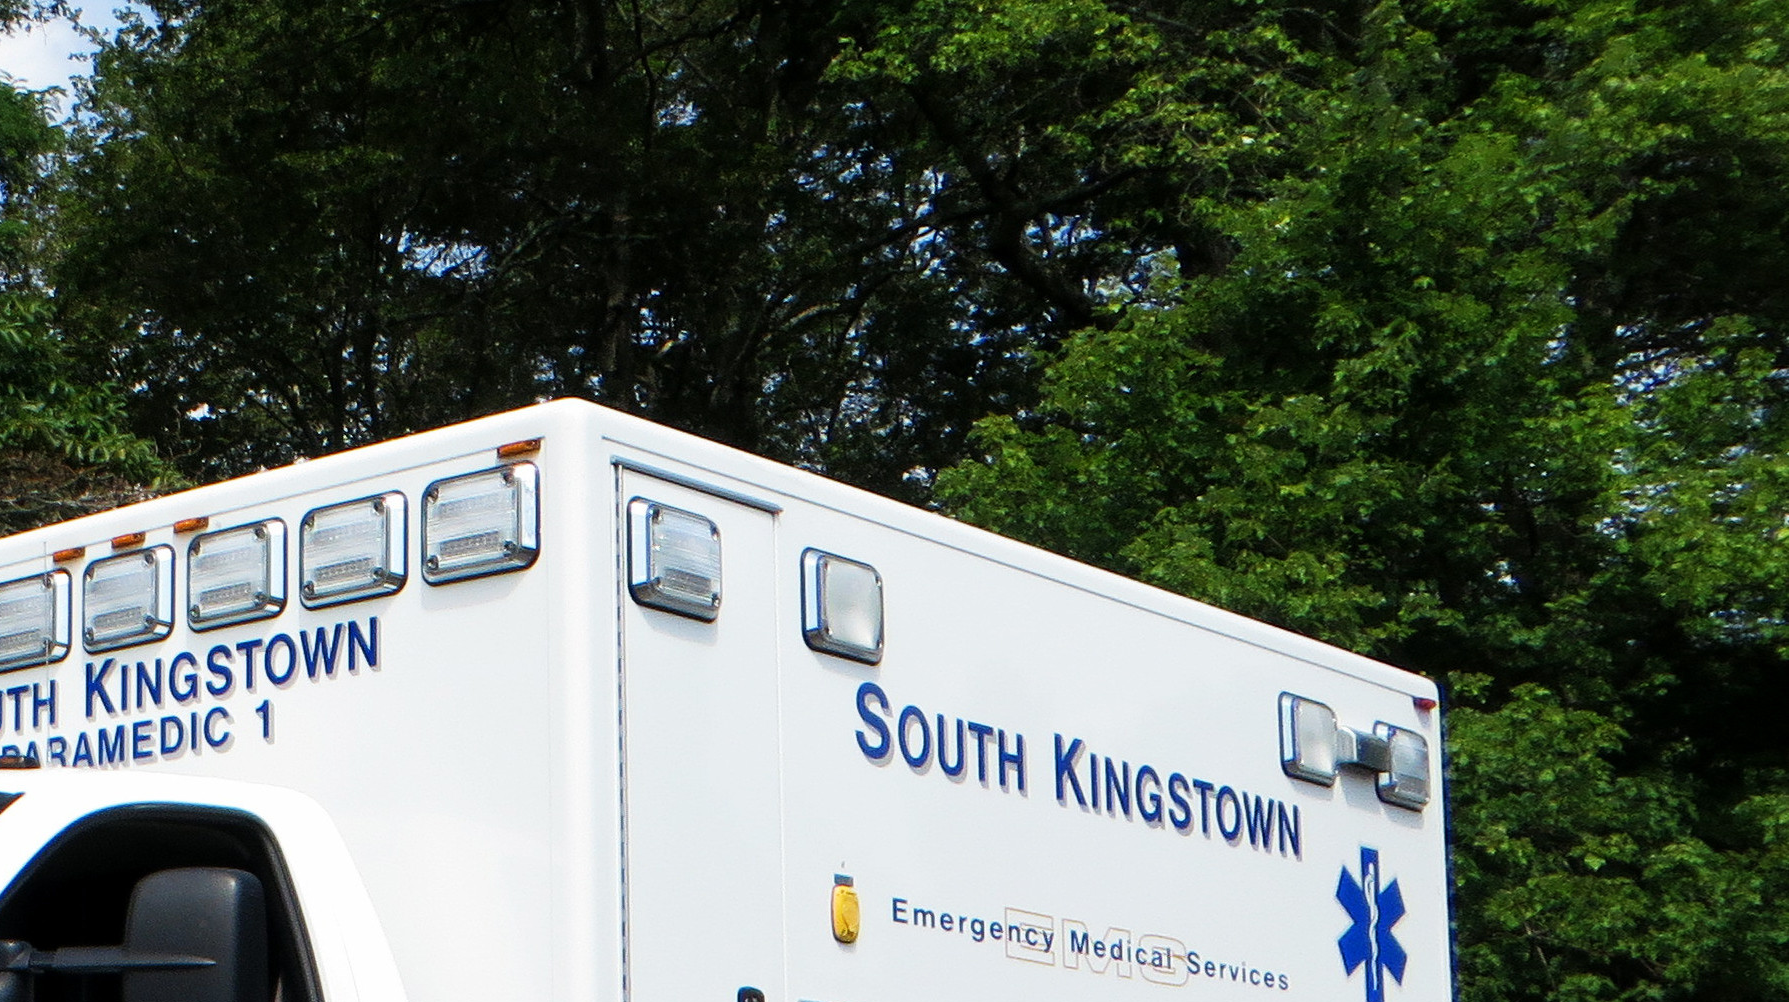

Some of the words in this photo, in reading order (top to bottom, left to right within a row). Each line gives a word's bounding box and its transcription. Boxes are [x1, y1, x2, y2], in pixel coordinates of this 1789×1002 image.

[83, 616, 381, 719] KINGSTOWN
[0, 706, 236, 768] RAMEDIC
[255, 699, 273, 741] 1
[854, 681, 1026, 793] SOUTH
[1053, 733, 1303, 859] KINGSTOWN
[892, 897, 1054, 953] Emergency
[1070, 929, 1172, 970] Medical
[1186, 951, 1290, 991] Services
[1004, 906, 1189, 988] EMS
